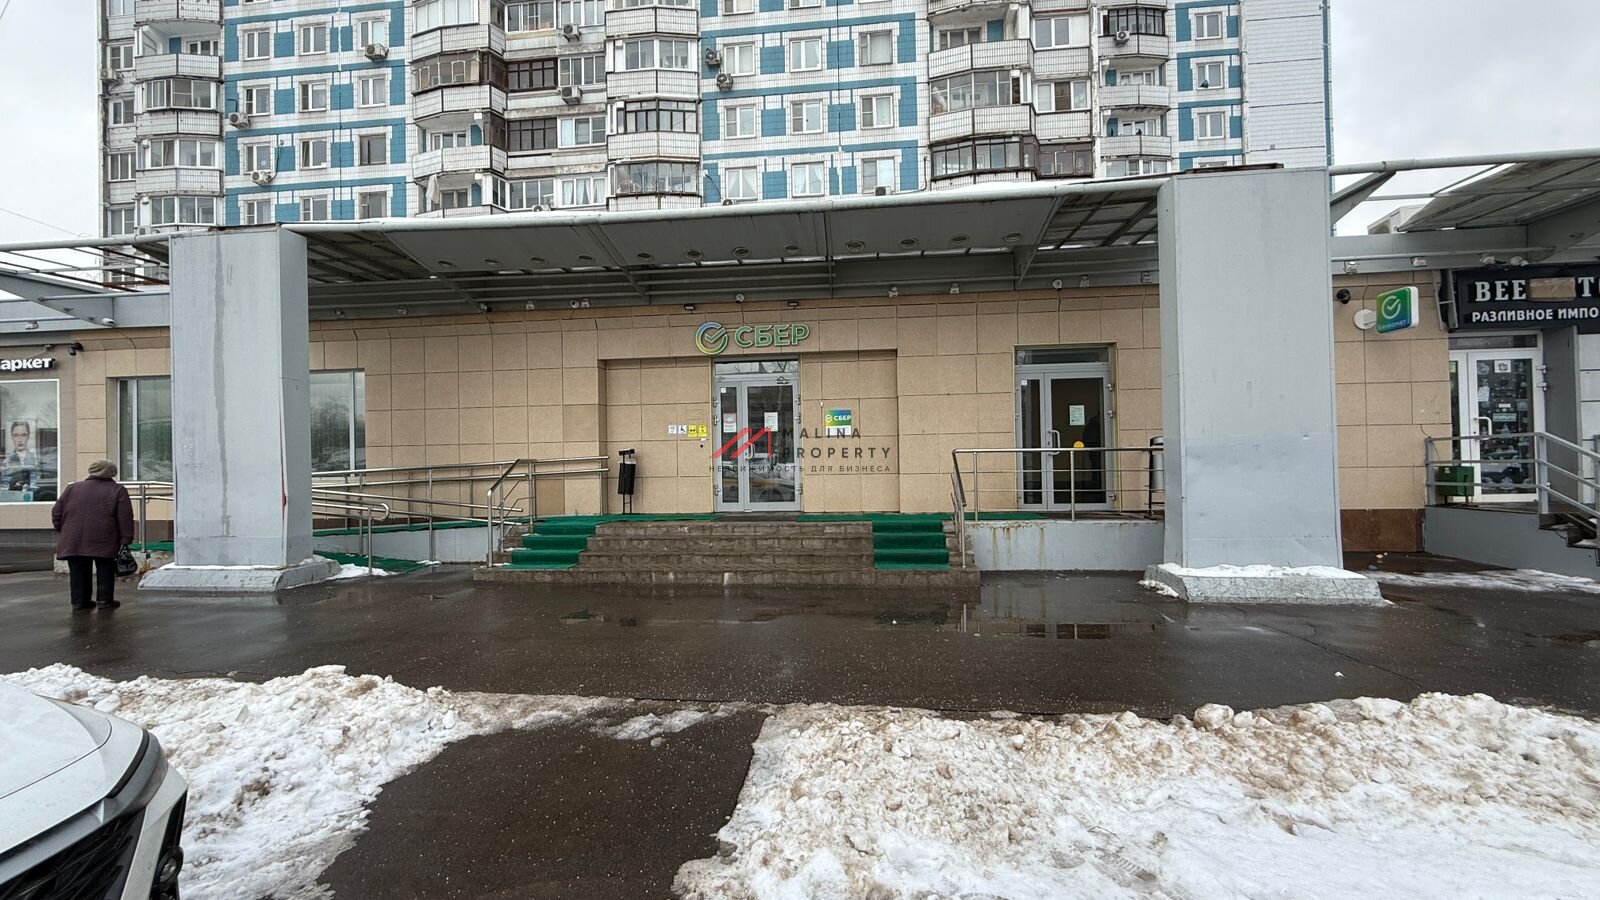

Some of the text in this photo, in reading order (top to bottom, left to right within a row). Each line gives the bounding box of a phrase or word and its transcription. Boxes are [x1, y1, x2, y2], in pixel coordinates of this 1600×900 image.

[1475, 276, 1600, 301] BEE T
[1472, 307, 1599, 322] РАЗЛИВНОЕ ИМПО
[735, 323, 810, 348] СБЕР
[0, 358, 52, 371] аркет
